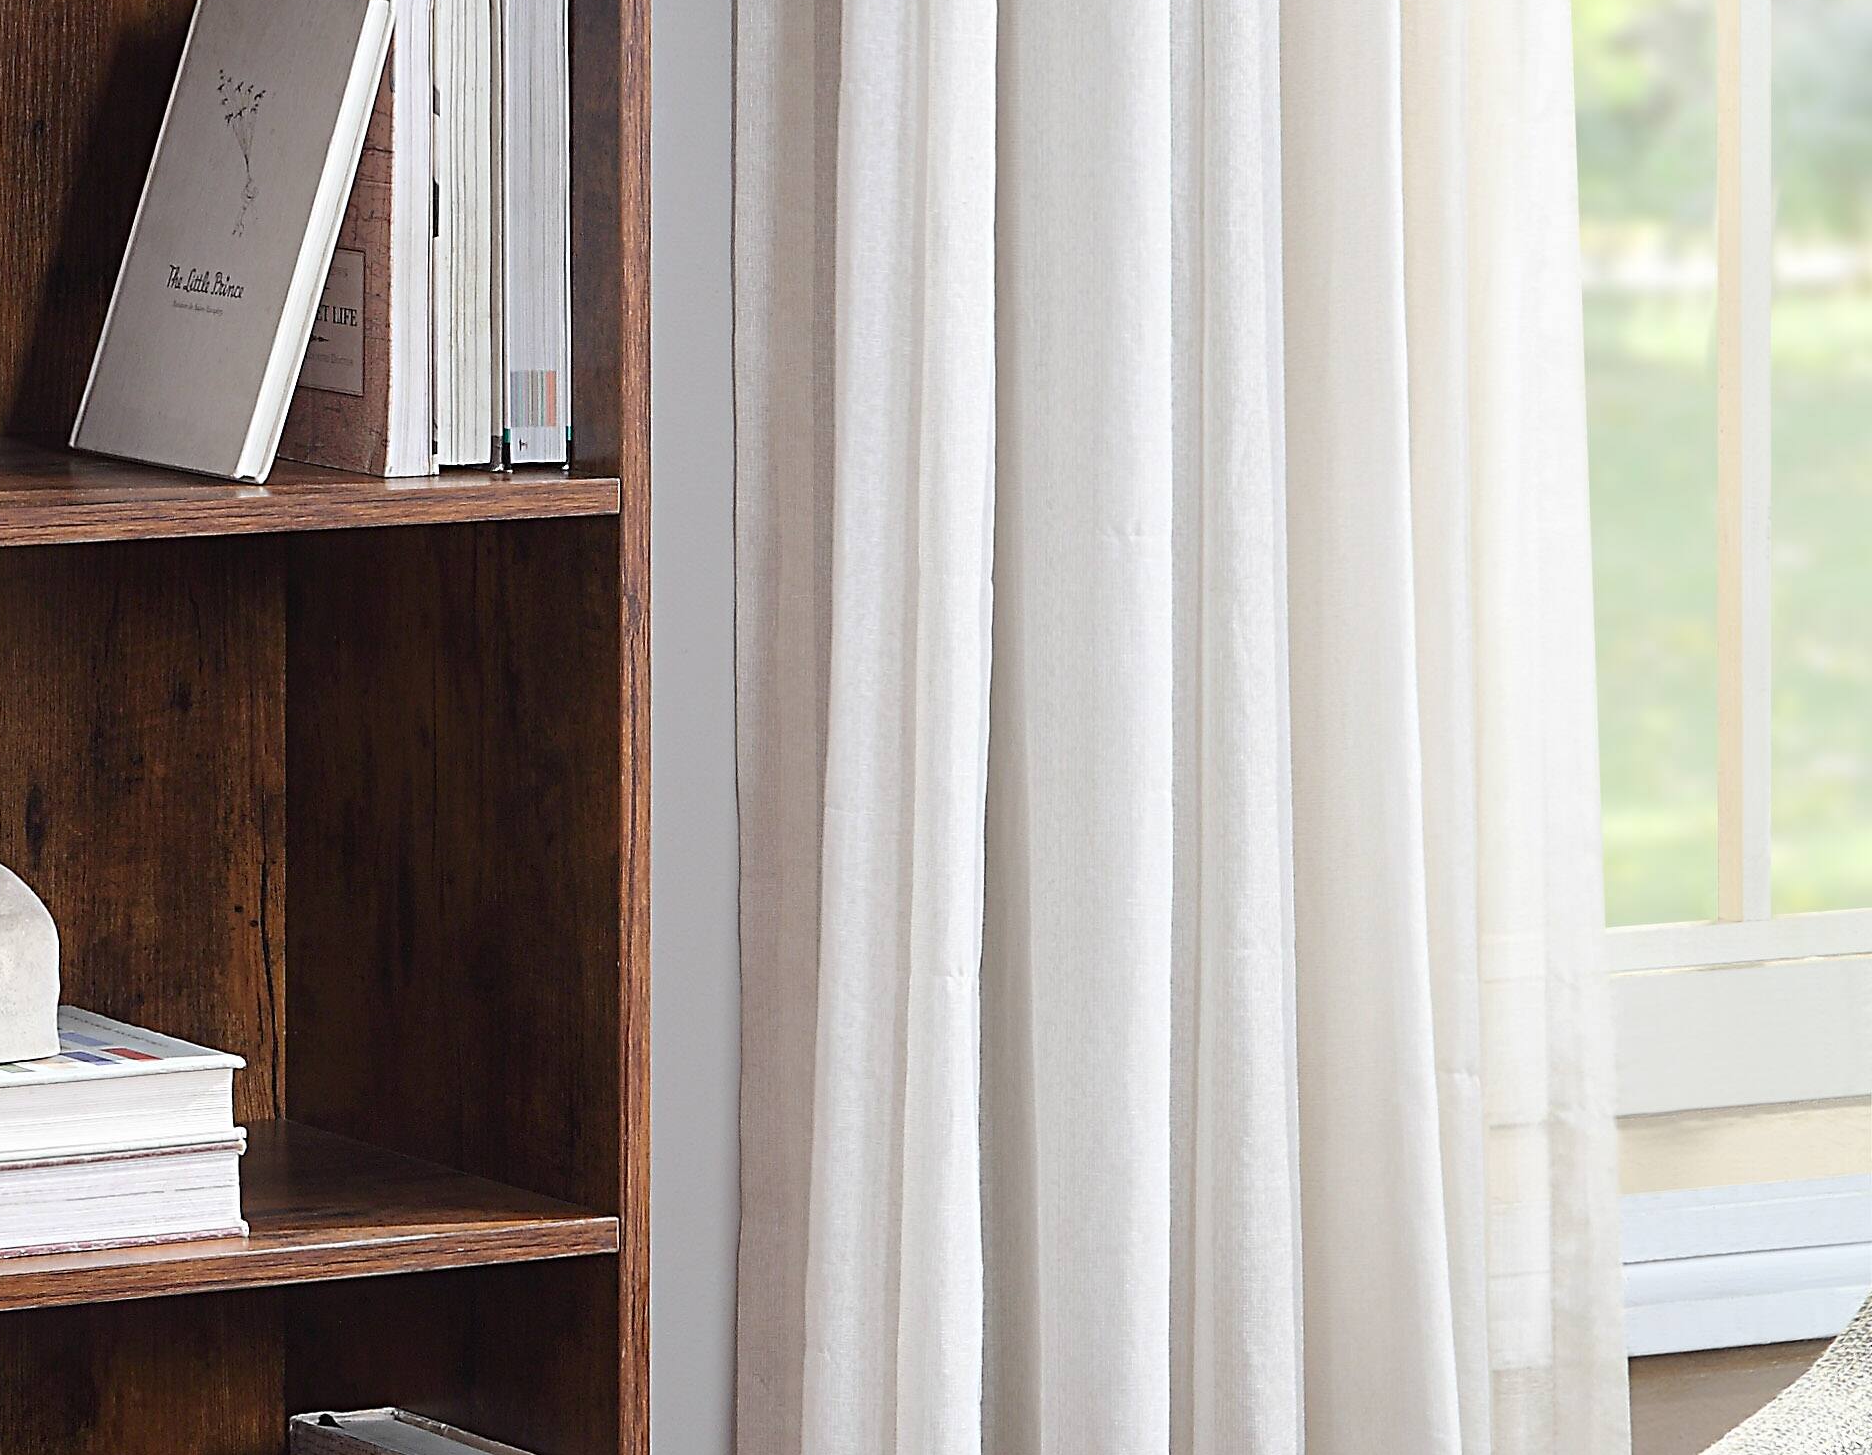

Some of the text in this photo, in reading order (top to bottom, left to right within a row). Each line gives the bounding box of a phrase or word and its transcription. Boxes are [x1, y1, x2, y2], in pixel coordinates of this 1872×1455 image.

[167, 264, 244, 298] The Little Prince
[332, 306, 358, 326] LIFE
